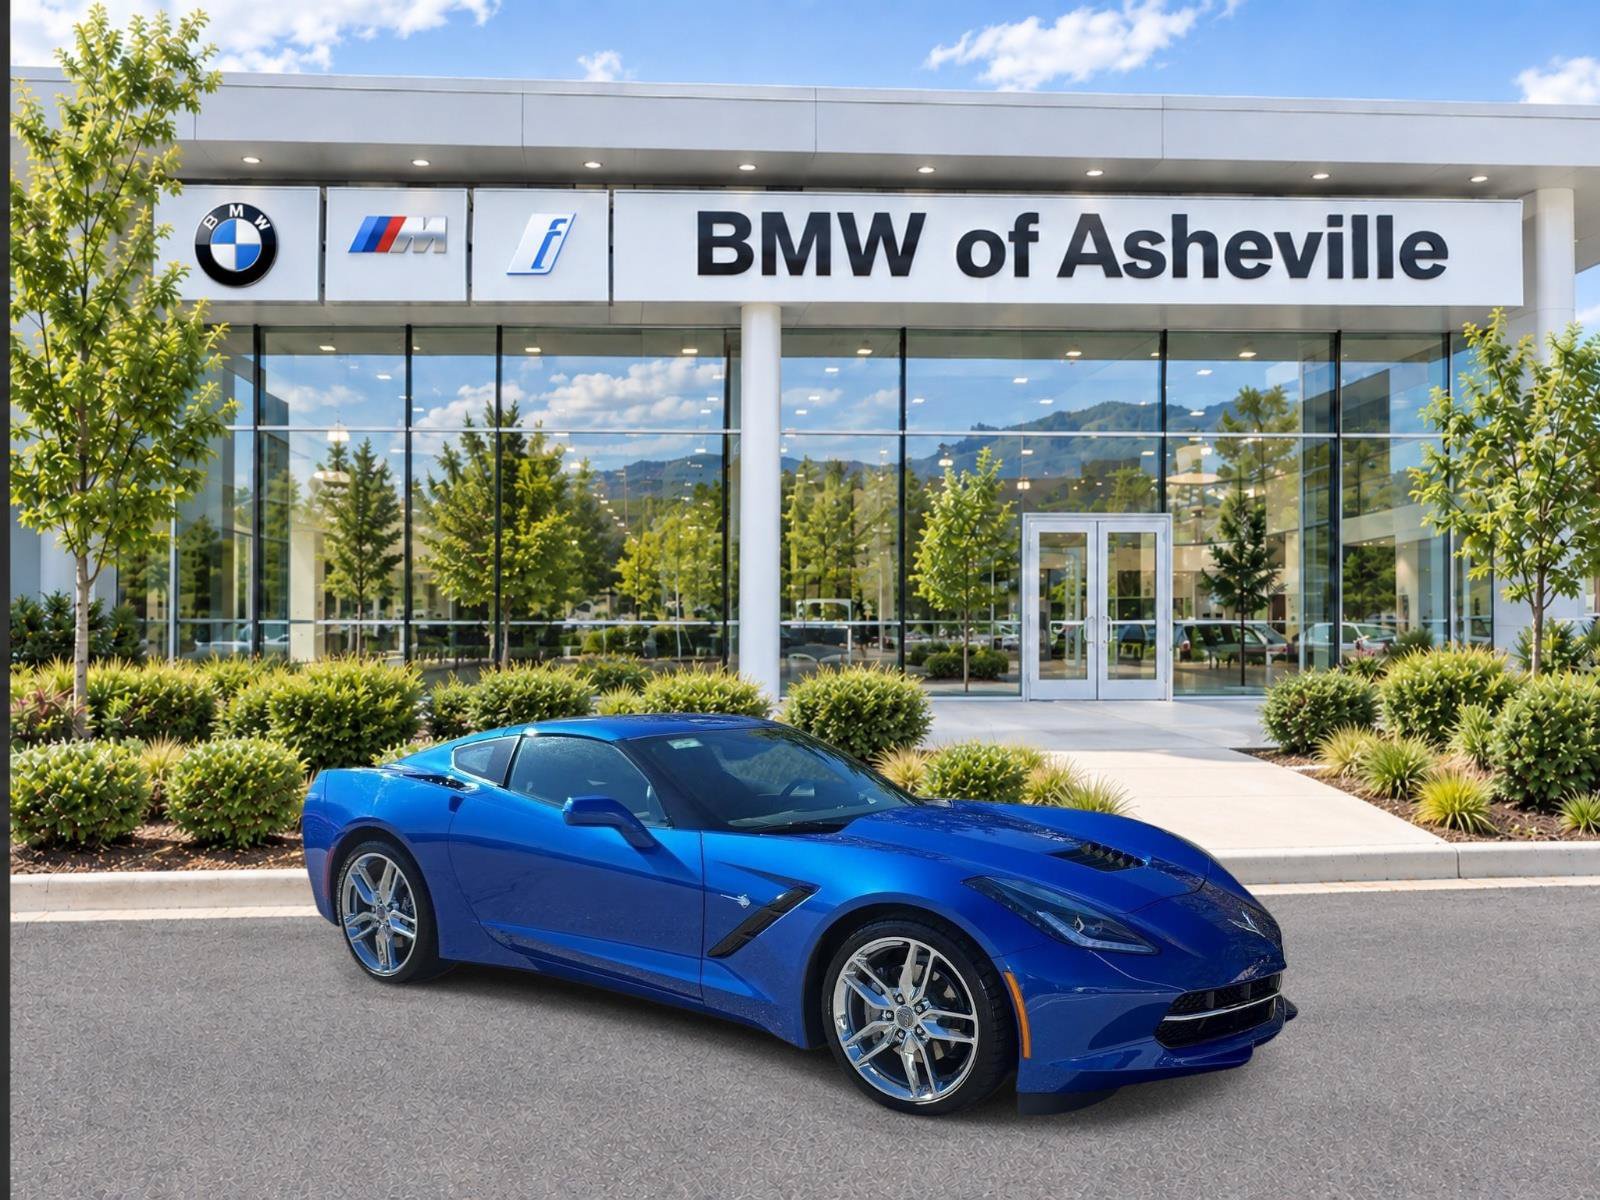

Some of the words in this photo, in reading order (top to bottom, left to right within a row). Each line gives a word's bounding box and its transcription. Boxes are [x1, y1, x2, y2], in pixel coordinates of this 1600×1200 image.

[203, 204, 271, 230] BMW
[697, 210, 927, 277] BMW
[956, 212, 1040, 279] of
[1056, 213, 1449, 280] Asheville
